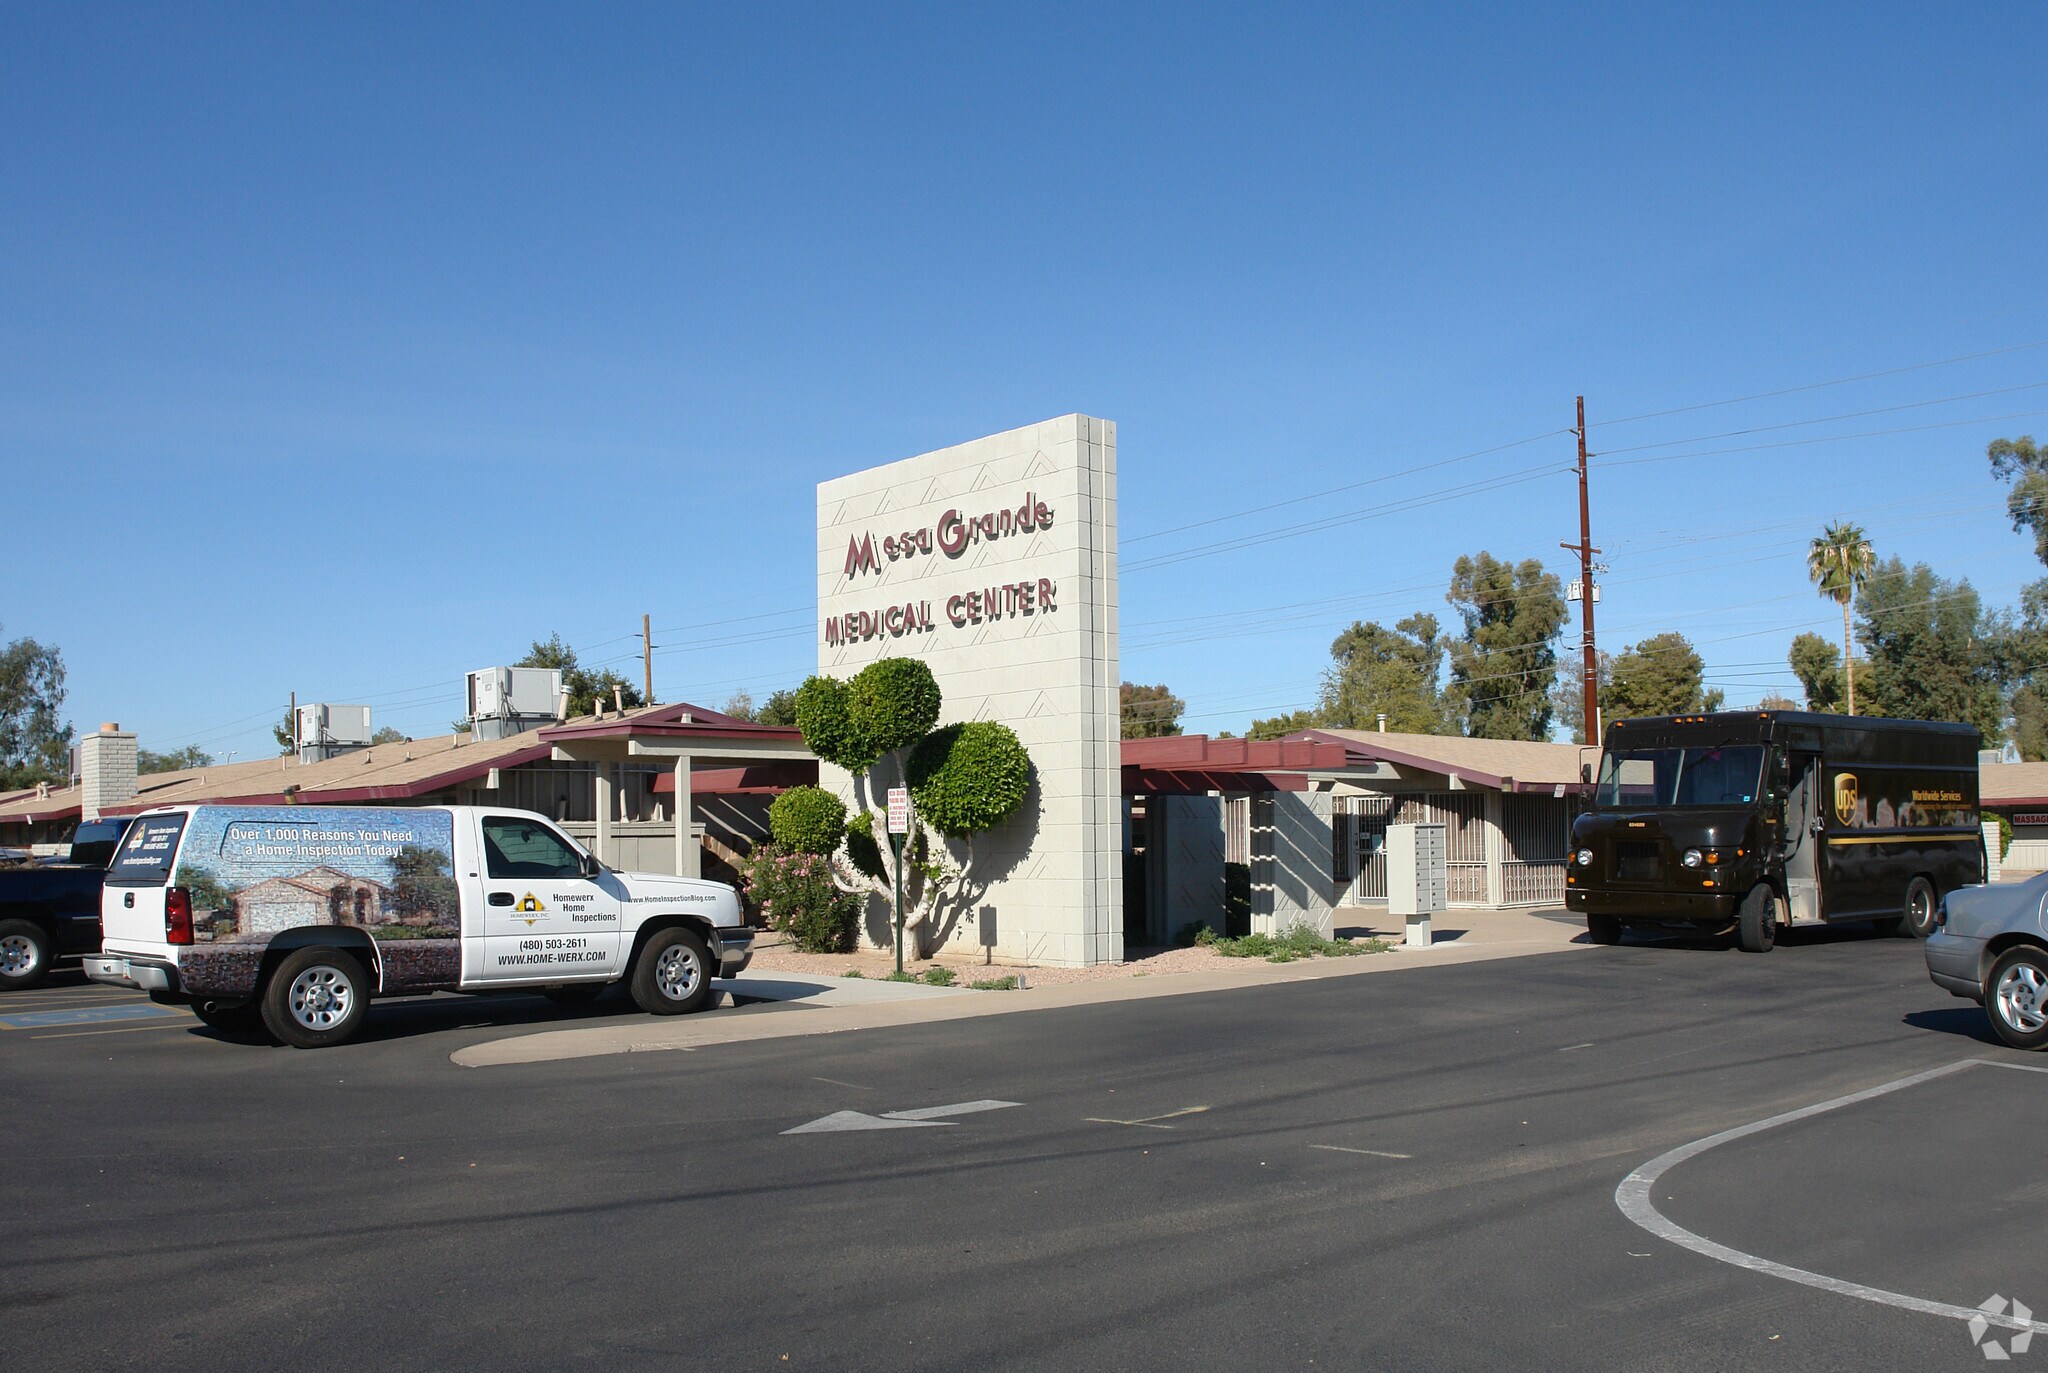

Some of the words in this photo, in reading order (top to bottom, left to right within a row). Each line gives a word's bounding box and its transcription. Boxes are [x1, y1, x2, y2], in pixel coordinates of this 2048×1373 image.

[844, 527, 933, 577] Mesa
[937, 491, 1055, 557] Grande
[825, 599, 936, 645] MEDICAL
[946, 577, 1058, 624] CENTER
[1911, 789, 1940, 801] Worldwide
[1940, 790, 1962, 801] Services
[1836, 789, 1856, 818] ups
[231, 828, 260, 841] Over
[265, 829, 299, 842] 1,000
[303, 829, 355, 841] Reasons
[358, 829, 381, 841] You
[381, 830, 412, 842] Need
[245, 846, 253, 855] a
[257, 844, 293, 855] Home
[297, 844, 364, 858] Inspection
[364, 845, 404, 858] Today!
[553, 894, 595, 902] Homewerx
[563, 904, 585, 912] Home
[572, 913, 617, 923] Inspections
[519, 939, 543, 953] (480)
[545, 938, 587, 950] 503-2611
[498, 951, 606, 966] WWW.HOME-WERX.COM
